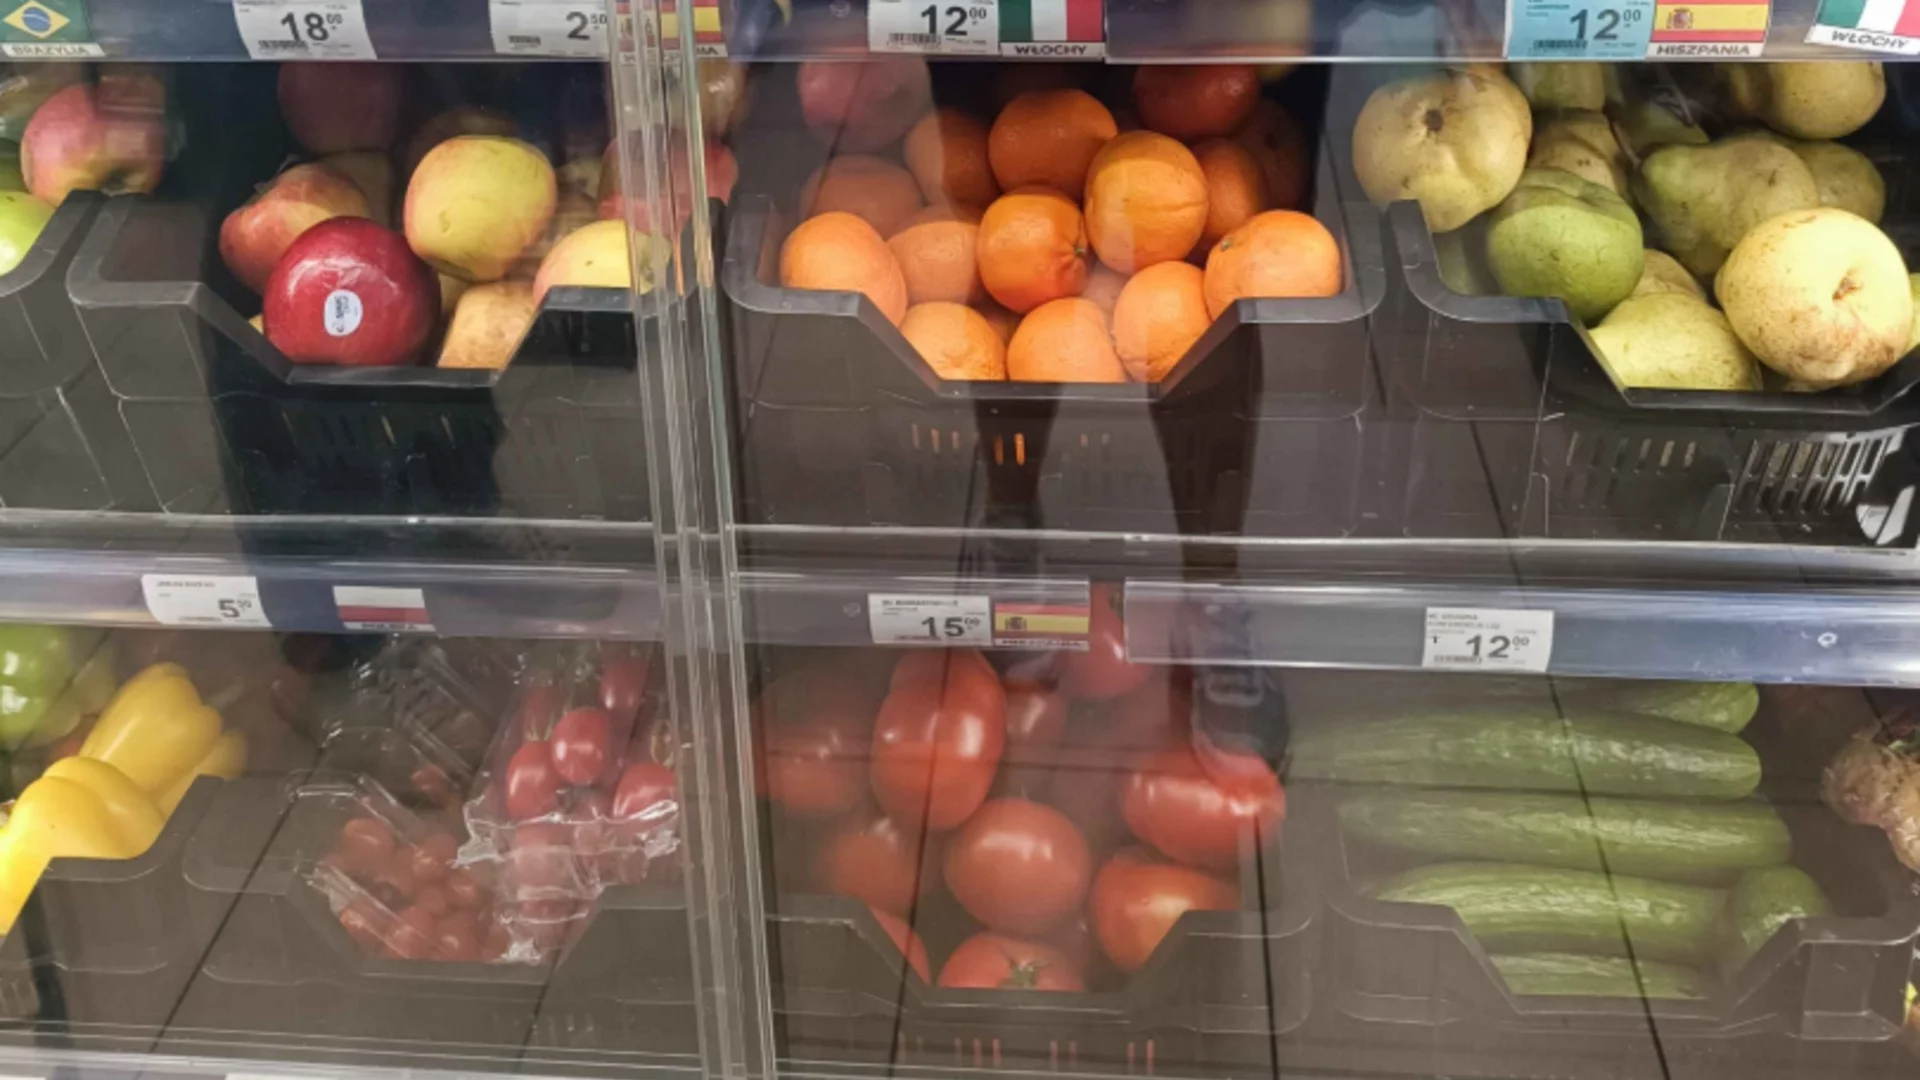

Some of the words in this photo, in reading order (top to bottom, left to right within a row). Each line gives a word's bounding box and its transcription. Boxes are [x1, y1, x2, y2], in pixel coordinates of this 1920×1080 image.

[1832, 31, 1908, 48] WŁOCHY
[12, 45, 92, 56] BRAZYLIA
[1014, 44, 1088, 55] WŁOCHY
[1656, 44, 1751, 56] HISZPANIA
